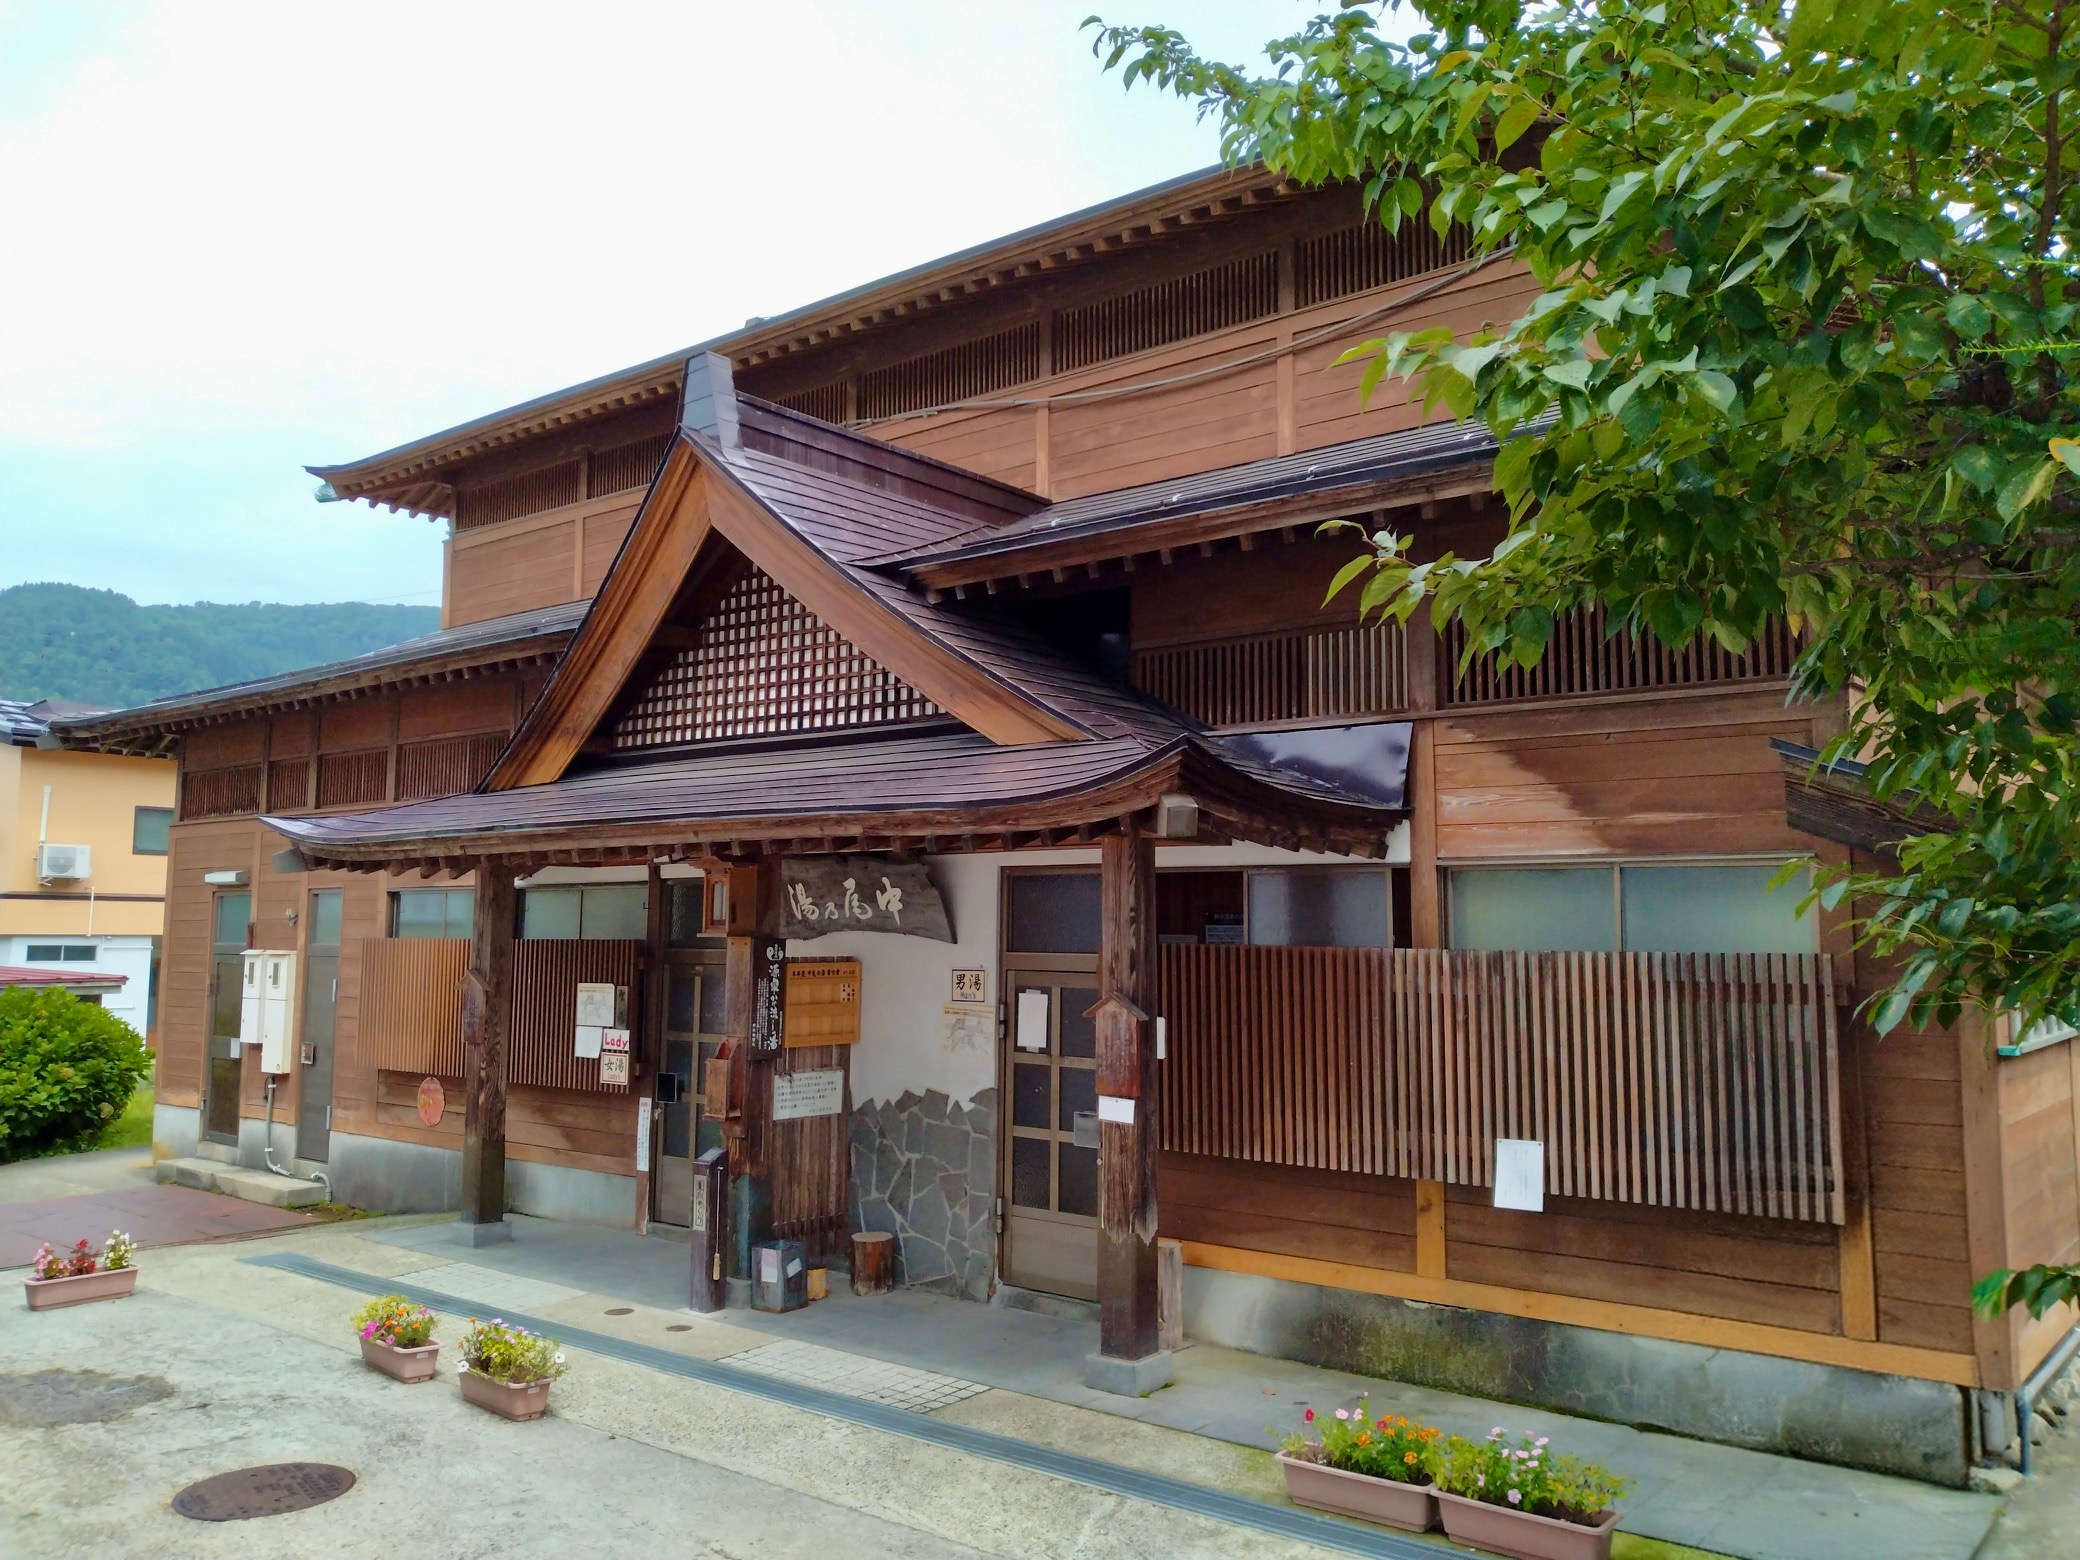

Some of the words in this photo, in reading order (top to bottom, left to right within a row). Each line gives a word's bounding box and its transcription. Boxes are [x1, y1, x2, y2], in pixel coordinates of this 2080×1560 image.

[955, 973, 982, 991] 男湯
[604, 1032, 628, 1049] Lady
[604, 1057, 624, 1073] 女湯
